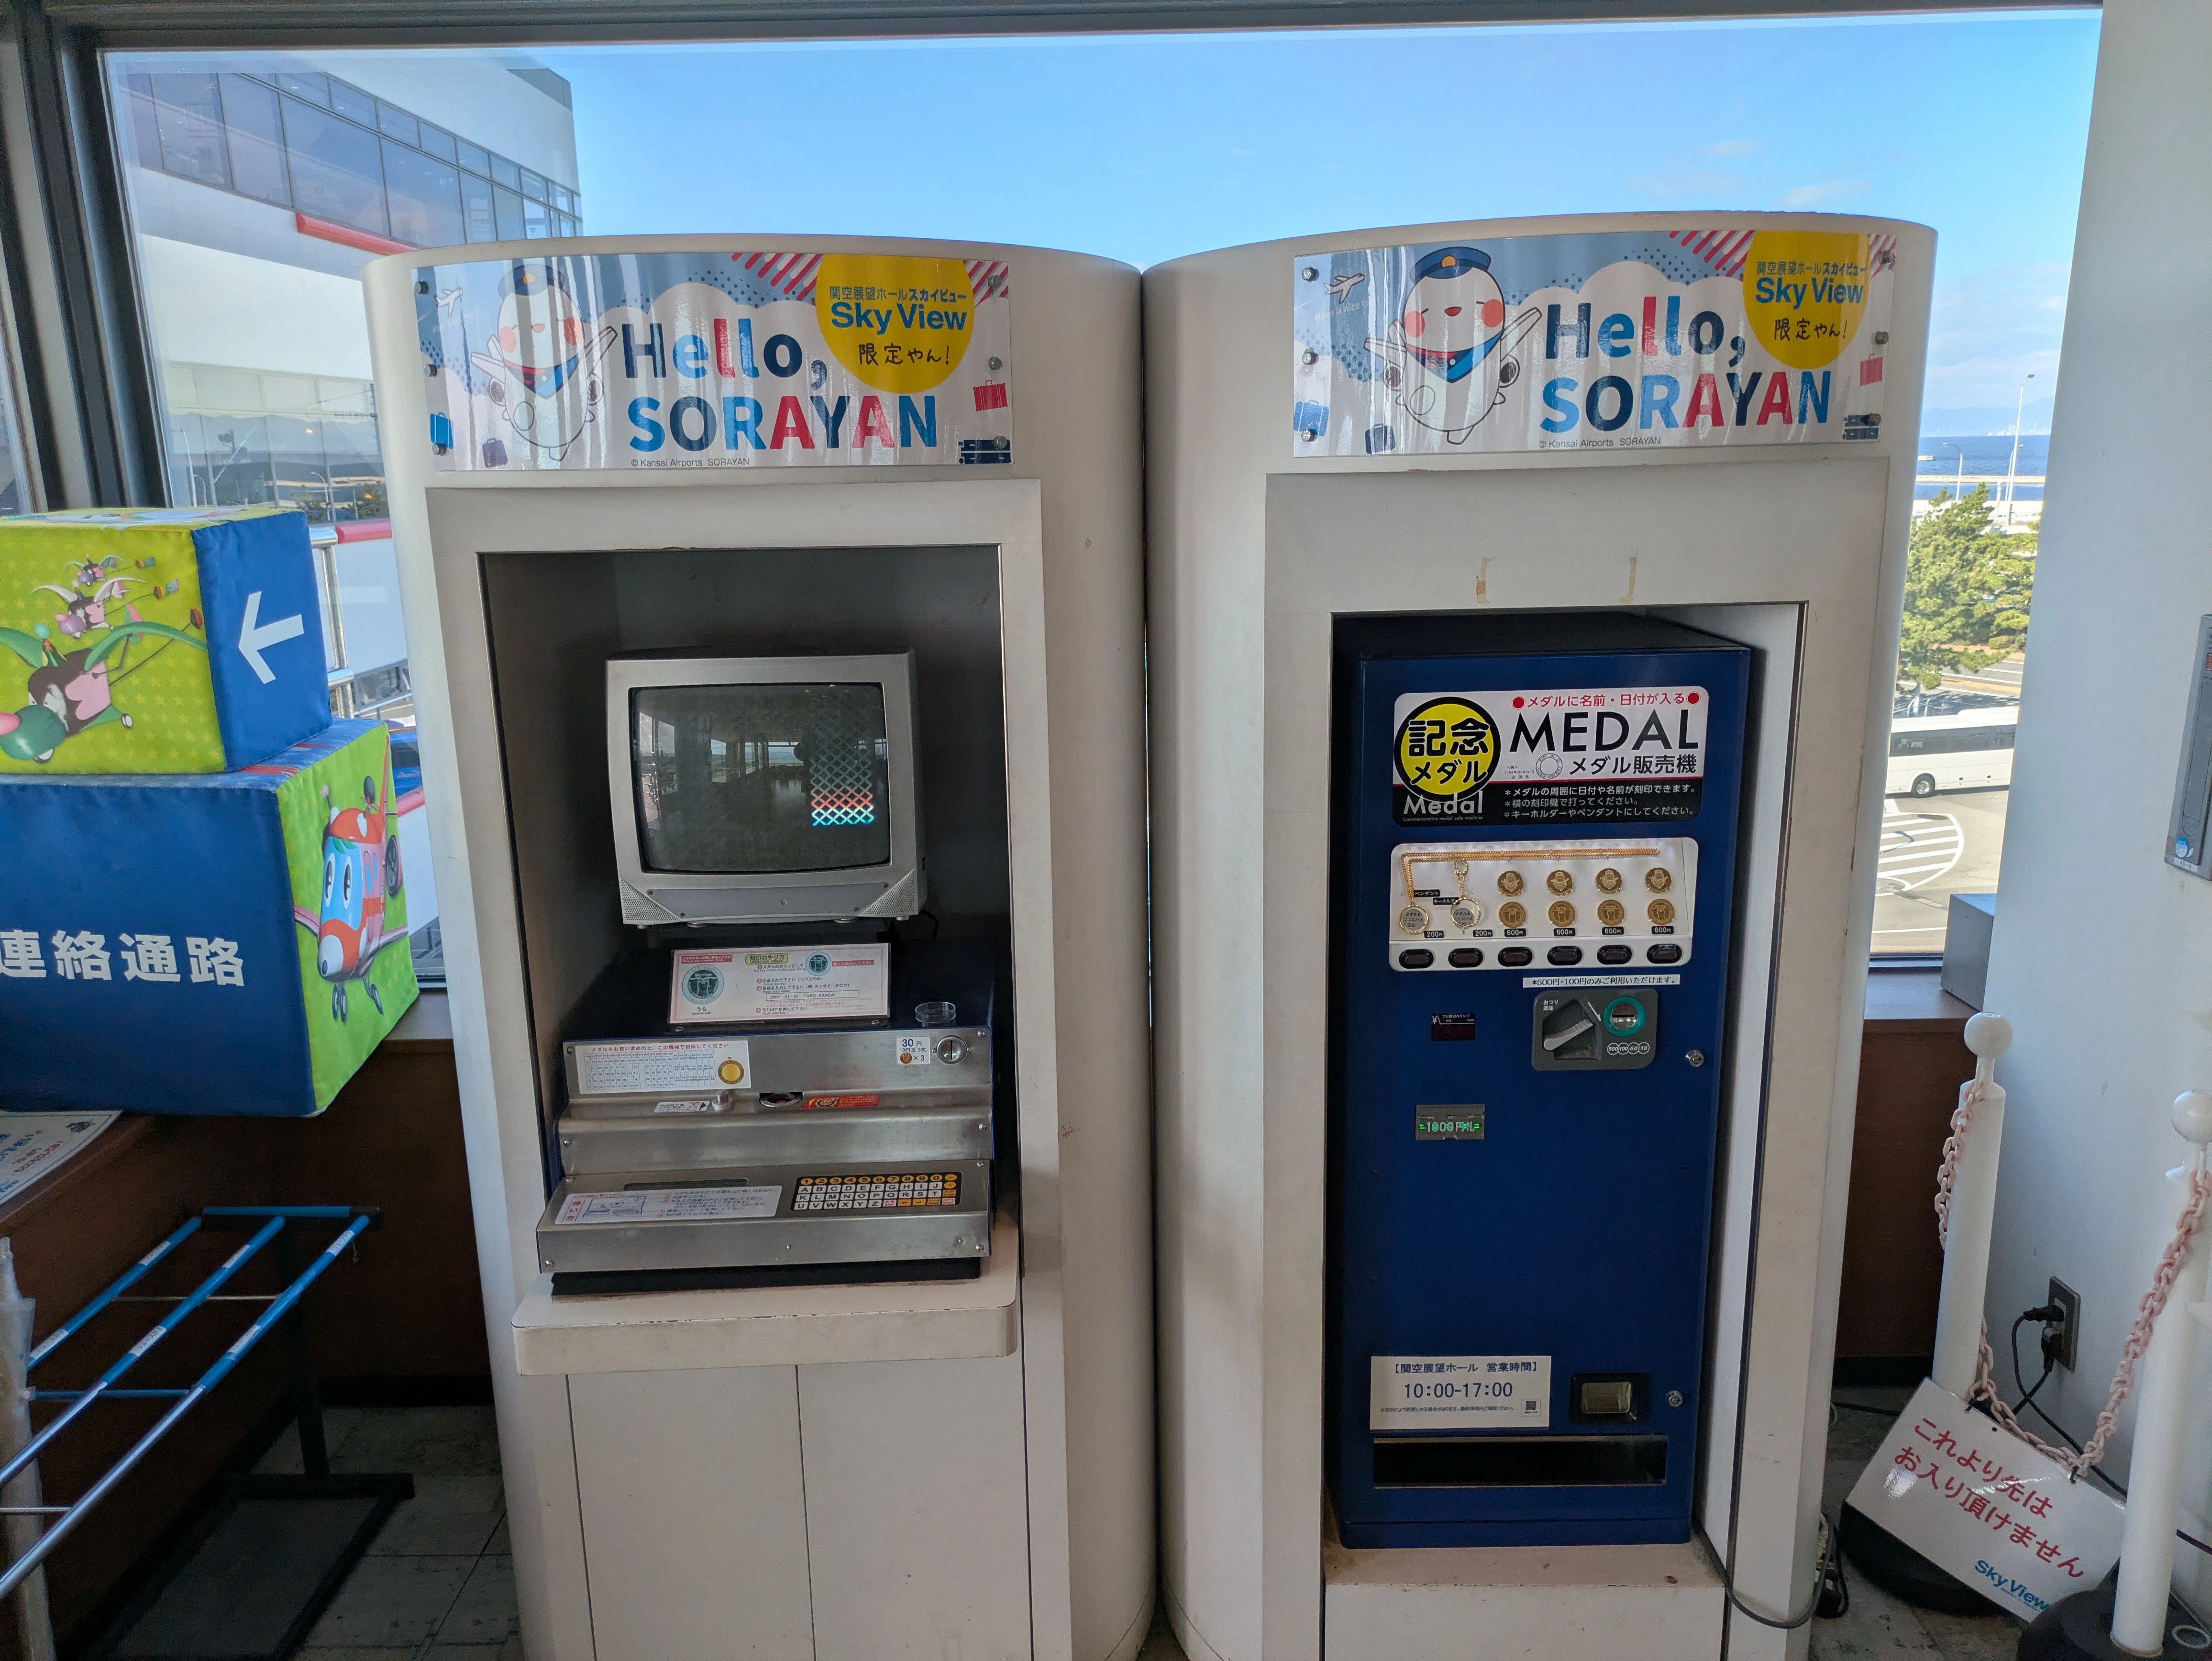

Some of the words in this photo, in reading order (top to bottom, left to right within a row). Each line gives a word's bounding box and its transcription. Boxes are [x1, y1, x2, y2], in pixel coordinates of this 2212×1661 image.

[1757, 261, 1866, 276] 関空展望ホールスカイビュー
[830, 286, 966, 302] 関空展望ホールスカイビュー
[1755, 277, 1807, 310] Sky
[1811, 277, 1864, 304] View
[831, 302, 892, 335] Sky
[896, 303, 967, 330] View
[1546, 295, 1745, 367] Hello,
[1774, 318, 1847, 341] 限定やん!
[622, 318, 827, 390] Hello,
[859, 343, 949, 365] 限定やん!
[1540, 371, 1831, 433] SORAYAN
[628, 395, 937, 452] SORAYAN
[1549, 440, 1578, 448] Kansai
[1580, 439, 1614, 448] Airports
[1619, 437, 1661, 446] SORAYAN
[641, 459, 667, 467] Kansai
[670, 459, 702, 467] Airports
[708, 458, 750, 466] SORAYAN
[1408, 718, 1490, 757] 記念
[1509, 709, 1698, 753] MEDAL
[1411, 759, 1488, 785] メダル
[1570, 754, 1697, 775] メダル販売機
[1403, 790, 1483, 815] Medal
[0, 930, 244, 986] 連絡通路
[902, 1039, 914, 1047] 30
[1405, 1382, 1513, 1398] 10:00-17:00
[1913, 1417, 2053, 1518] これより先は
[1894, 1447, 2084, 1578] お入り頂けません
[1974, 1560, 2008, 1587] Sky
[2010, 1579, 2050, 1610] View
